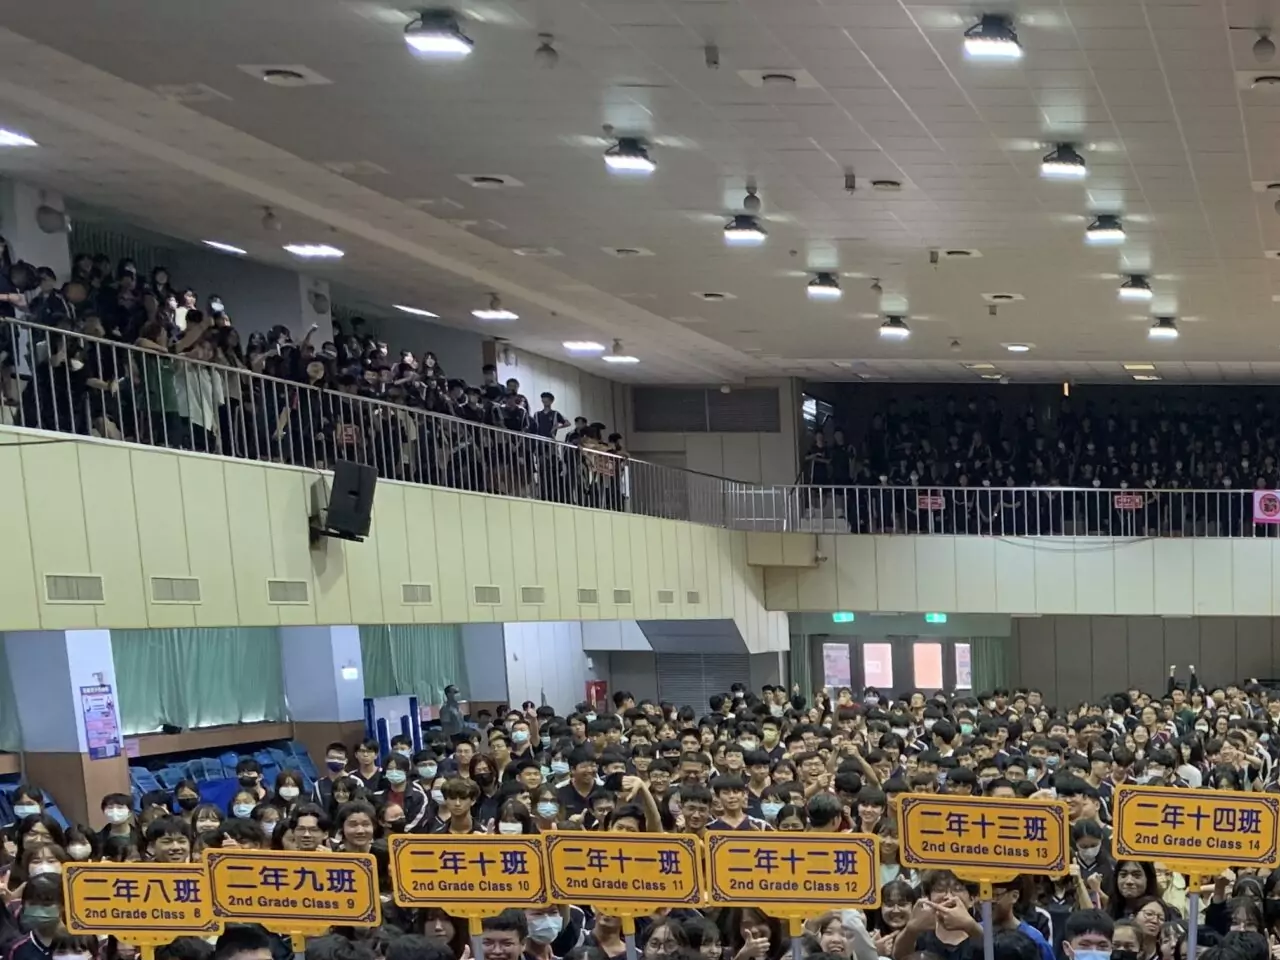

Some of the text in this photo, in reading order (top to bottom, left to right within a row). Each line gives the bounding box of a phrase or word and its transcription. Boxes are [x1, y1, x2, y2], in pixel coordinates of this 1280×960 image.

[920, 811, 1048, 842] 二年十三班
[1135, 802, 1262, 834] 二年十四班
[922, 841, 1048, 859] 2nd Grade Class 13
[1135, 833, 1260, 851] 2nd Grade Class 14
[409, 849, 528, 876] 二年十班
[563, 847, 682, 875] 二年十一班
[728, 848, 858, 876] 二年十二班
[226, 865, 358, 894] 二年九班
[412, 880, 529, 892] 2nd Grade Class 10
[566, 877, 684, 891] 2nd Grade Class 11
[729, 879, 857, 892] 2nd Grade Class 12
[83, 878, 202, 904] 二年八班
[228, 895, 355, 909] 2nd Grade Class 9
[84, 908, 200, 920] 2nd Grade Class 8
